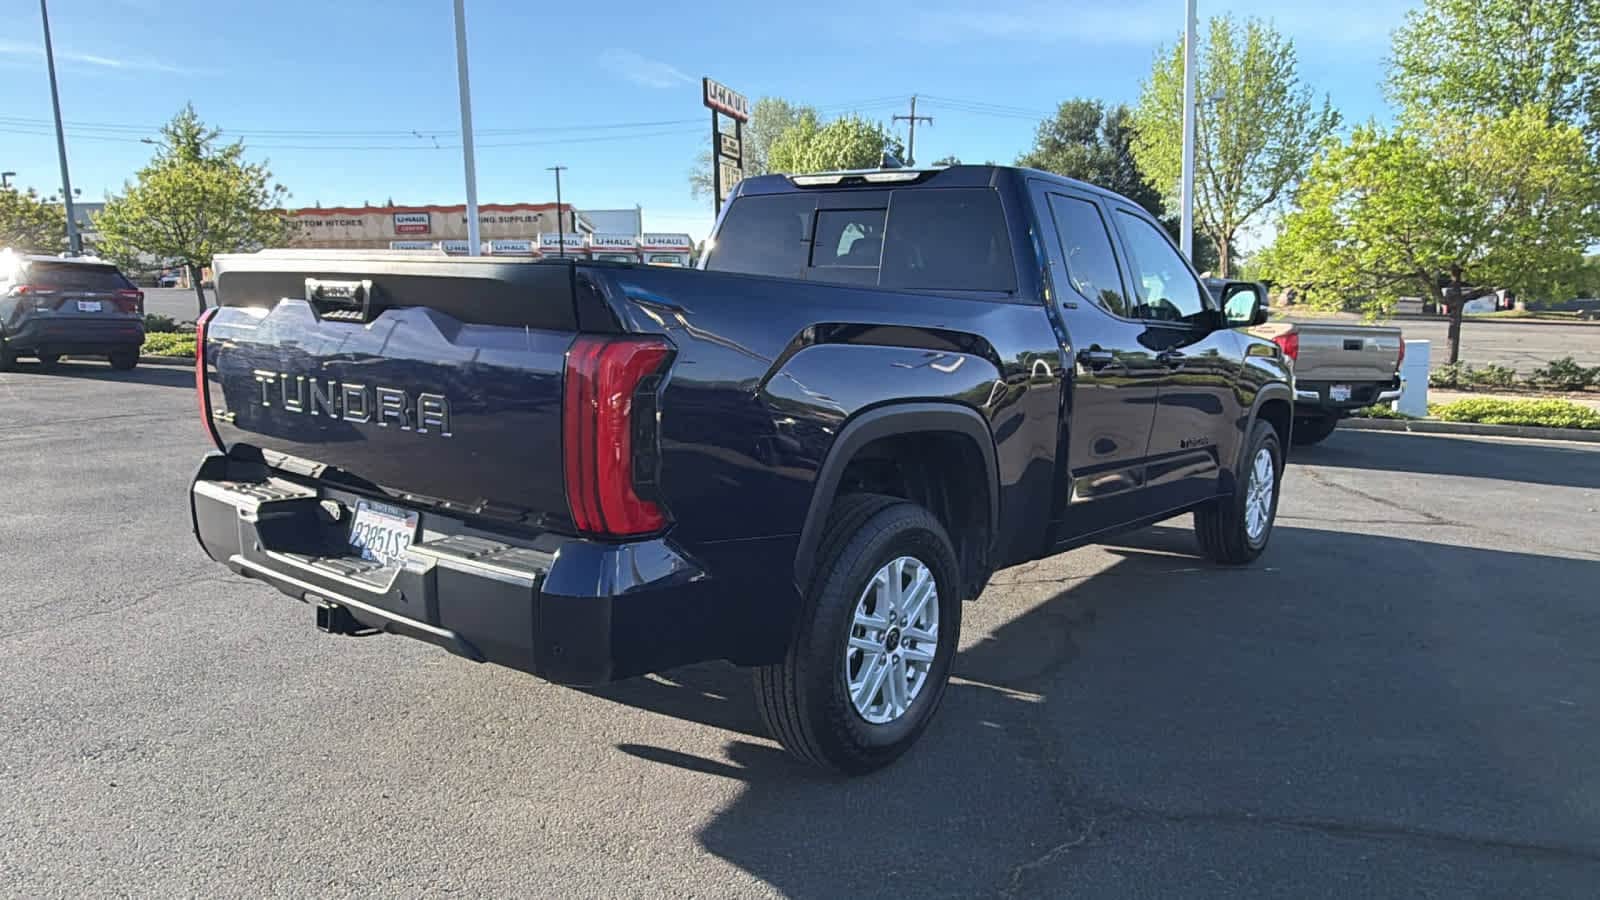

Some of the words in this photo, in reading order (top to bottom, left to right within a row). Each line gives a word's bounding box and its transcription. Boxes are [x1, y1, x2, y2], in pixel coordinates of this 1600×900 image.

[325, 218, 363, 227] HITCHES
[498, 214, 539, 224] SUPPLIES
[596, 238, 632, 246] U-HAUL
[647, 237, 684, 246] U-HAUL
[253, 369, 453, 438] TUNDRA
